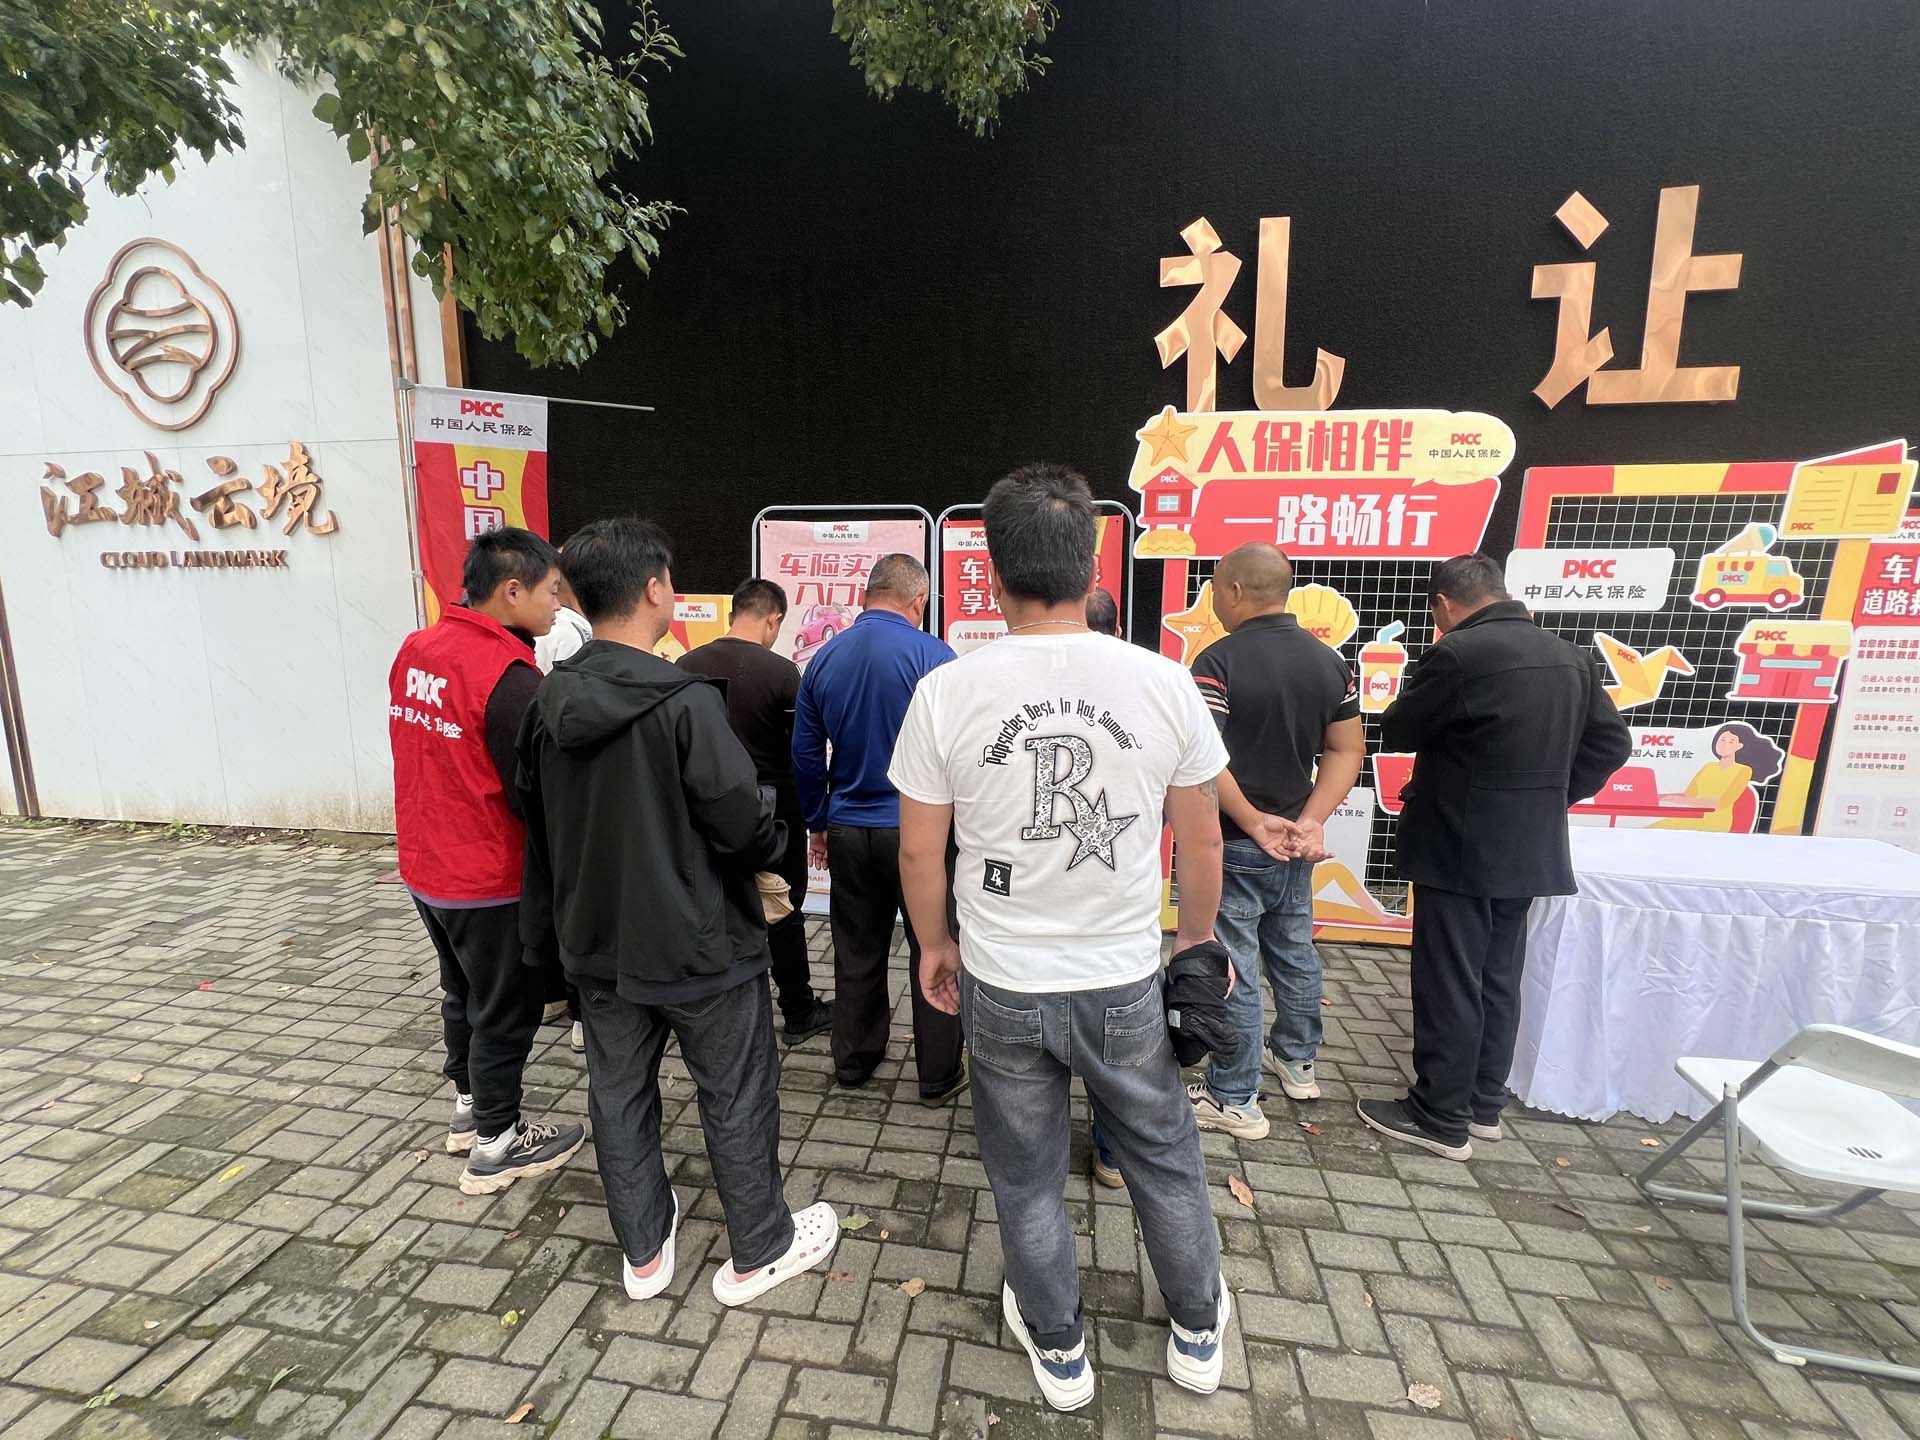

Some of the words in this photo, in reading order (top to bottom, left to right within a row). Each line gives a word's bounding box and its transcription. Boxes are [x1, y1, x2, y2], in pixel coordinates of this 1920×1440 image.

[1153, 216, 1346, 412] 礼
[1531, 184, 1744, 411] 让
[460, 399, 504, 418] PICC
[430, 417, 533, 436] 中国人民保险
[1197, 419, 1413, 472] 人保相伴
[1451, 433, 1482, 445] PICC
[1429, 449, 1501, 459] 中国人民保险
[1160, 475, 1178, 483] PICC
[39, 440, 338, 541] 江城云境
[1223, 493, 1438, 546] 一路畅行
[1791, 522, 1815, 530] PICC
[100, 551, 168, 569] CLOUD
[169, 550, 289, 568] LANDMARK
[779, 553, 890, 577] 车险实
[1880, 554, 1920, 584] 车
[1562, 560, 1616, 579] PICC
[1721, 574, 1745, 583] PICC
[795, 582, 866, 607] 入门
[1524, 584, 1647, 600] 中国人民保险
[1754, 630, 1787, 641] PICC
[1617, 648, 1636, 664] PICC
[406, 667, 447, 710] PICC
[1371, 681, 1389, 691] PICC
[978, 712, 1027, 768] Popsicles
[1022, 699, 1055, 731] Best
[1060, 697, 1071, 717] In
[1077, 698, 1096, 727] Hot
[1098, 711, 1143, 751] Summer
[1641, 735, 1675, 746] PICC
[1612, 783, 1633, 792] PICC
